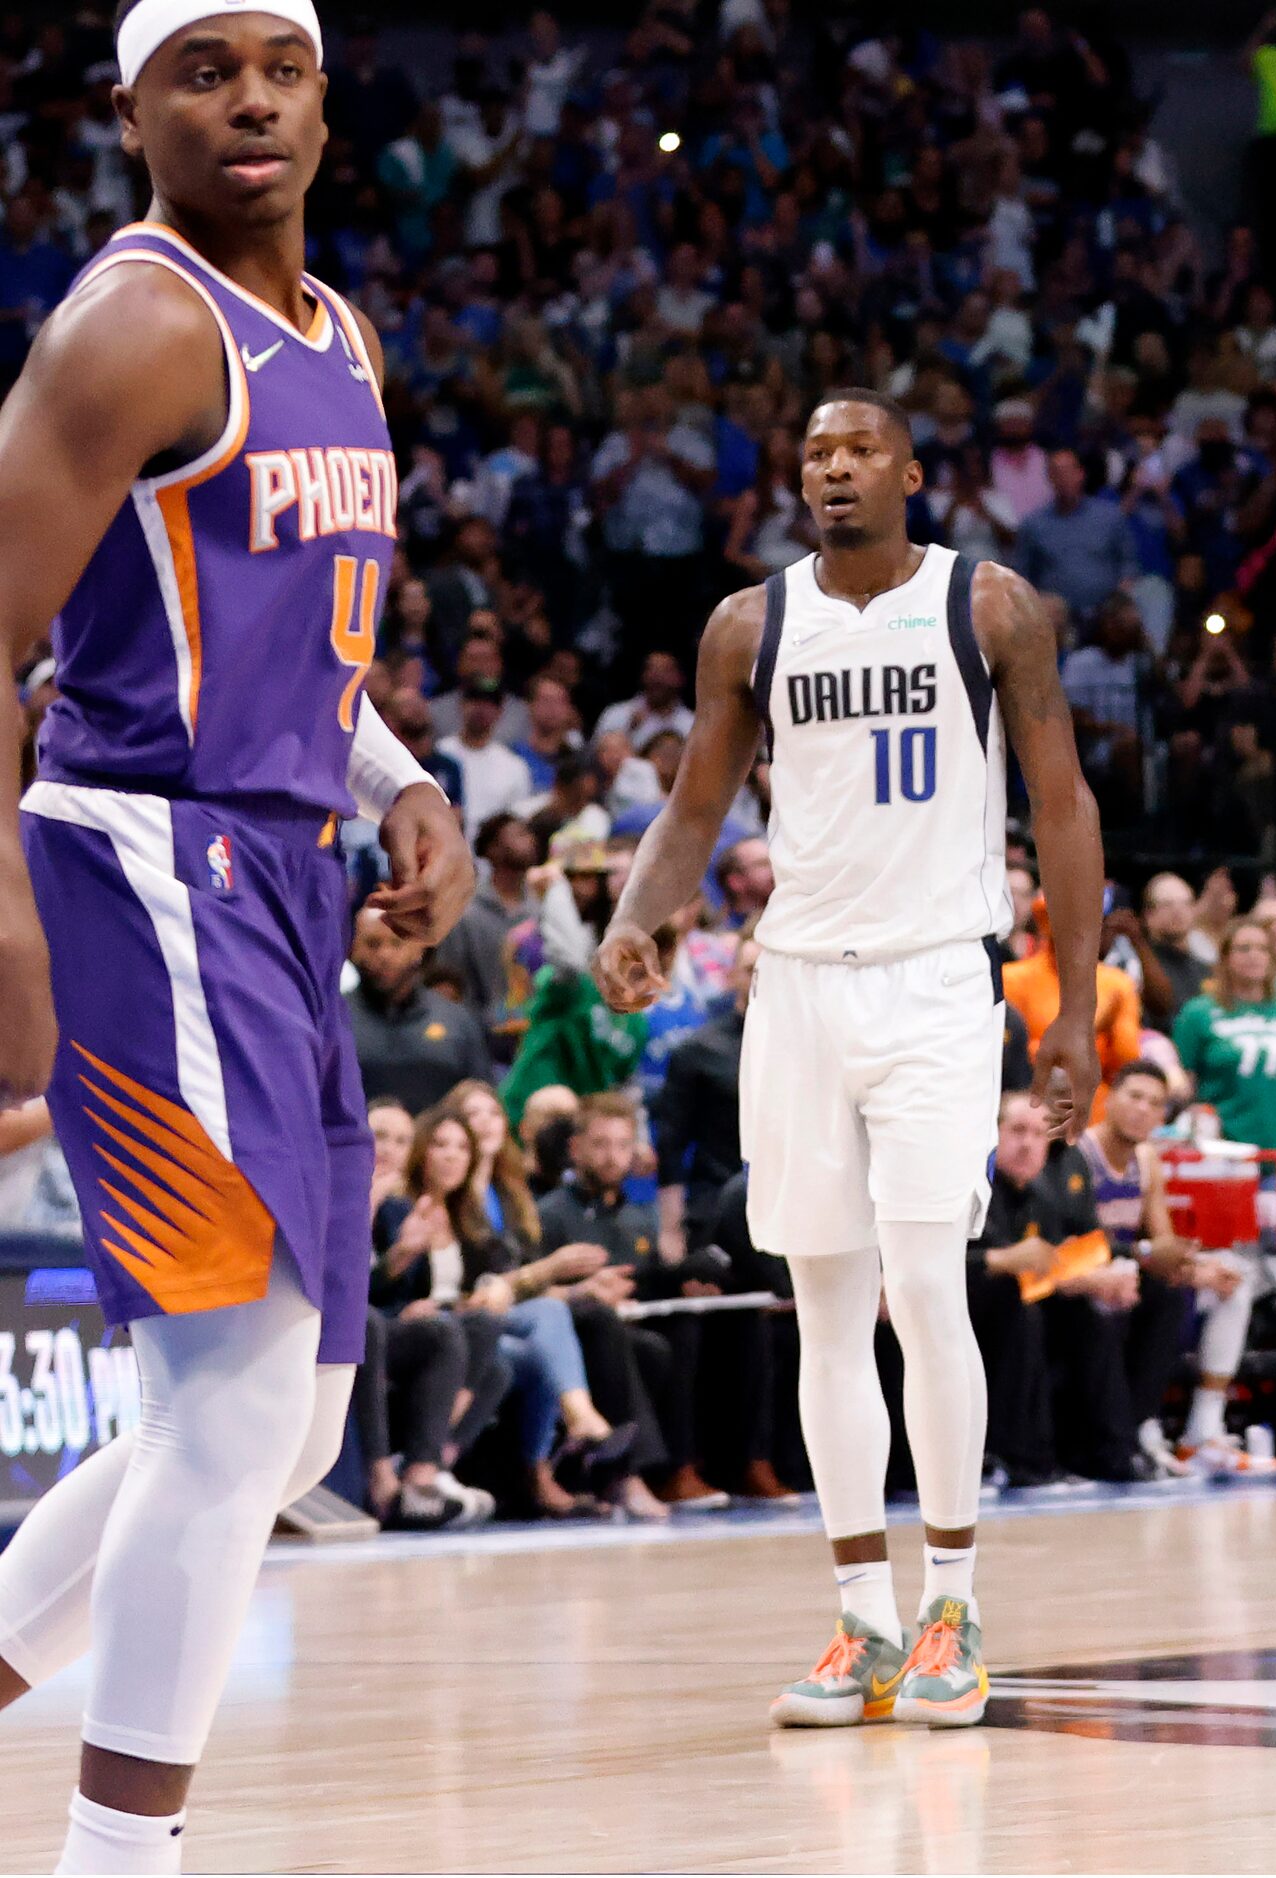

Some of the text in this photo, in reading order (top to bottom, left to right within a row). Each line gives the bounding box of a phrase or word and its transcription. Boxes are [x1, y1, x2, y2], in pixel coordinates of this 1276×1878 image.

[330, 554, 379, 733] 4
[787, 662, 938, 727] DALLAS
[869, 726, 938, 805] 10
